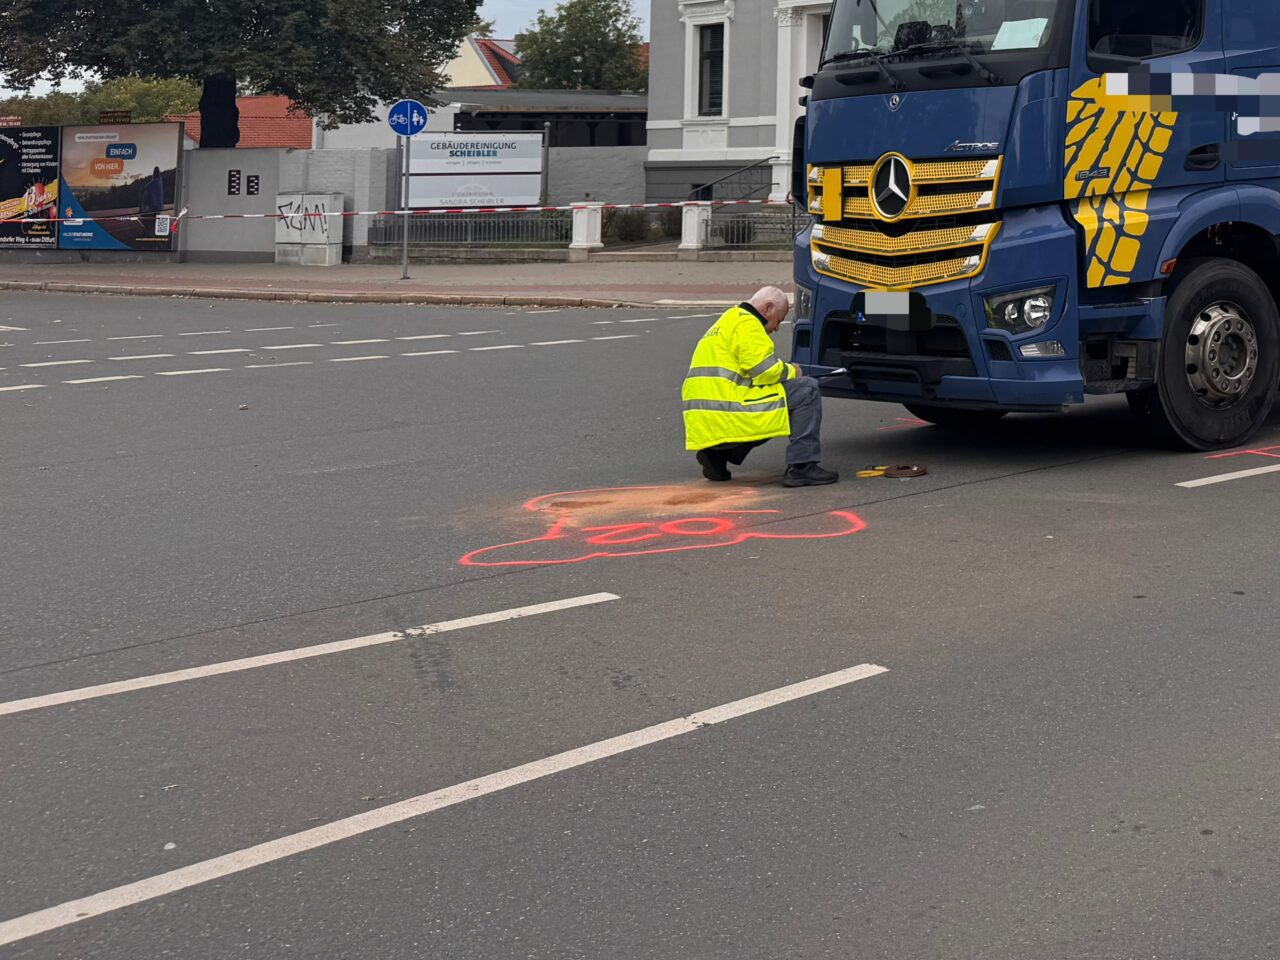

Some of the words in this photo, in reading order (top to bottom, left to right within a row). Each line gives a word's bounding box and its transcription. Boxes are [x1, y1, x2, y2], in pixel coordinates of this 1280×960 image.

[430, 141, 517, 150] GEBÄUDEREINIGUNG
[109, 147, 133, 156] EINFACH
[448, 150, 498, 158] SCHEIBLER
[94, 163, 106, 171] VON
[22, 185, 36, 210] 13
[440, 198, 468, 206] SANDRA
[469, 198, 504, 206] SCHEIBLER
